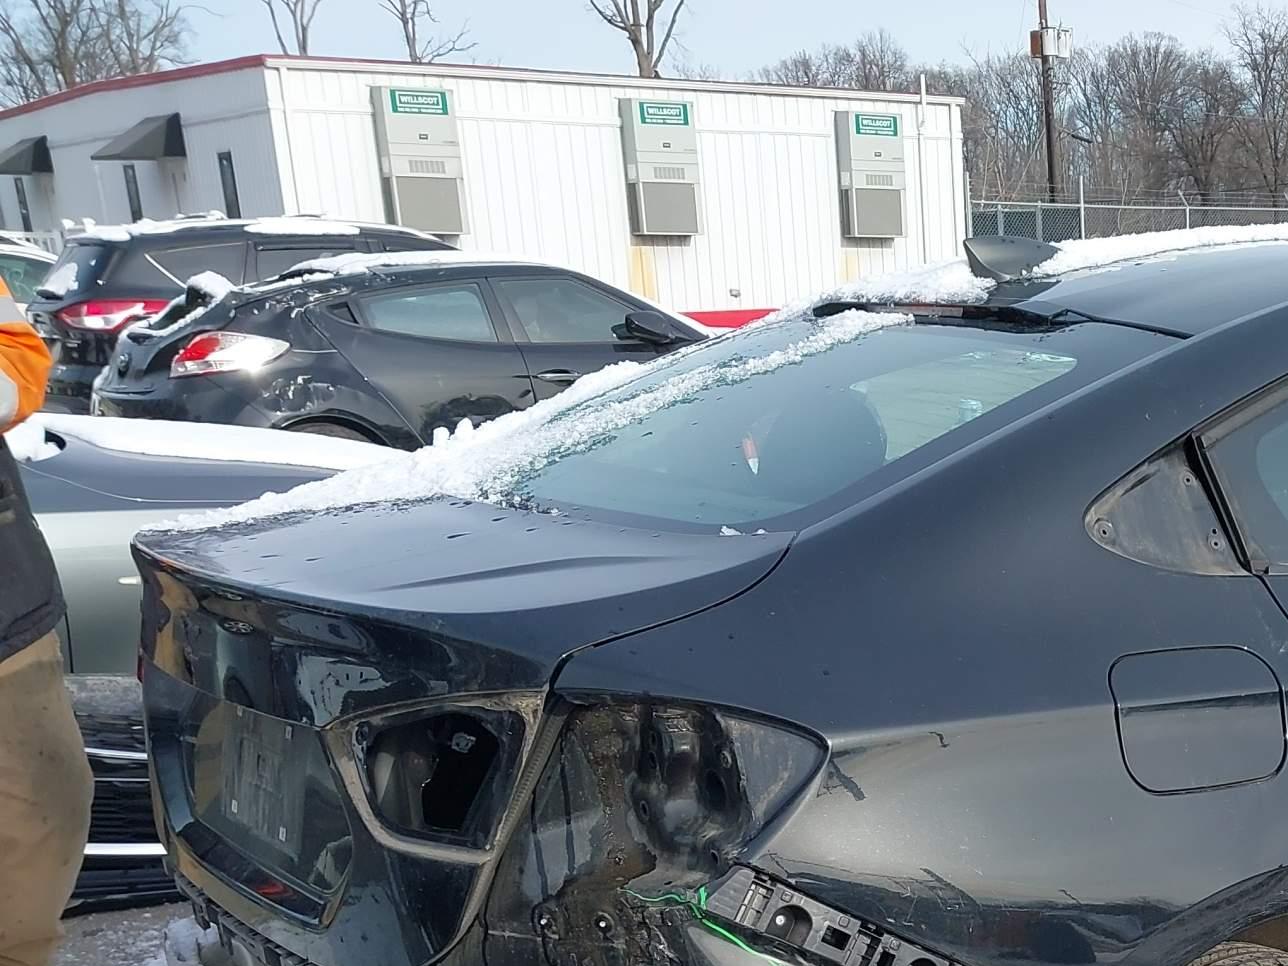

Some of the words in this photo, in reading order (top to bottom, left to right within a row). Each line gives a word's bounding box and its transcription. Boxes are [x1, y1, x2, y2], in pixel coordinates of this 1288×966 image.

[400, 95, 438, 104] WILLSCOT
[647, 107, 680, 115] WILLSCOT
[862, 119, 890, 127] WILLSCOT
